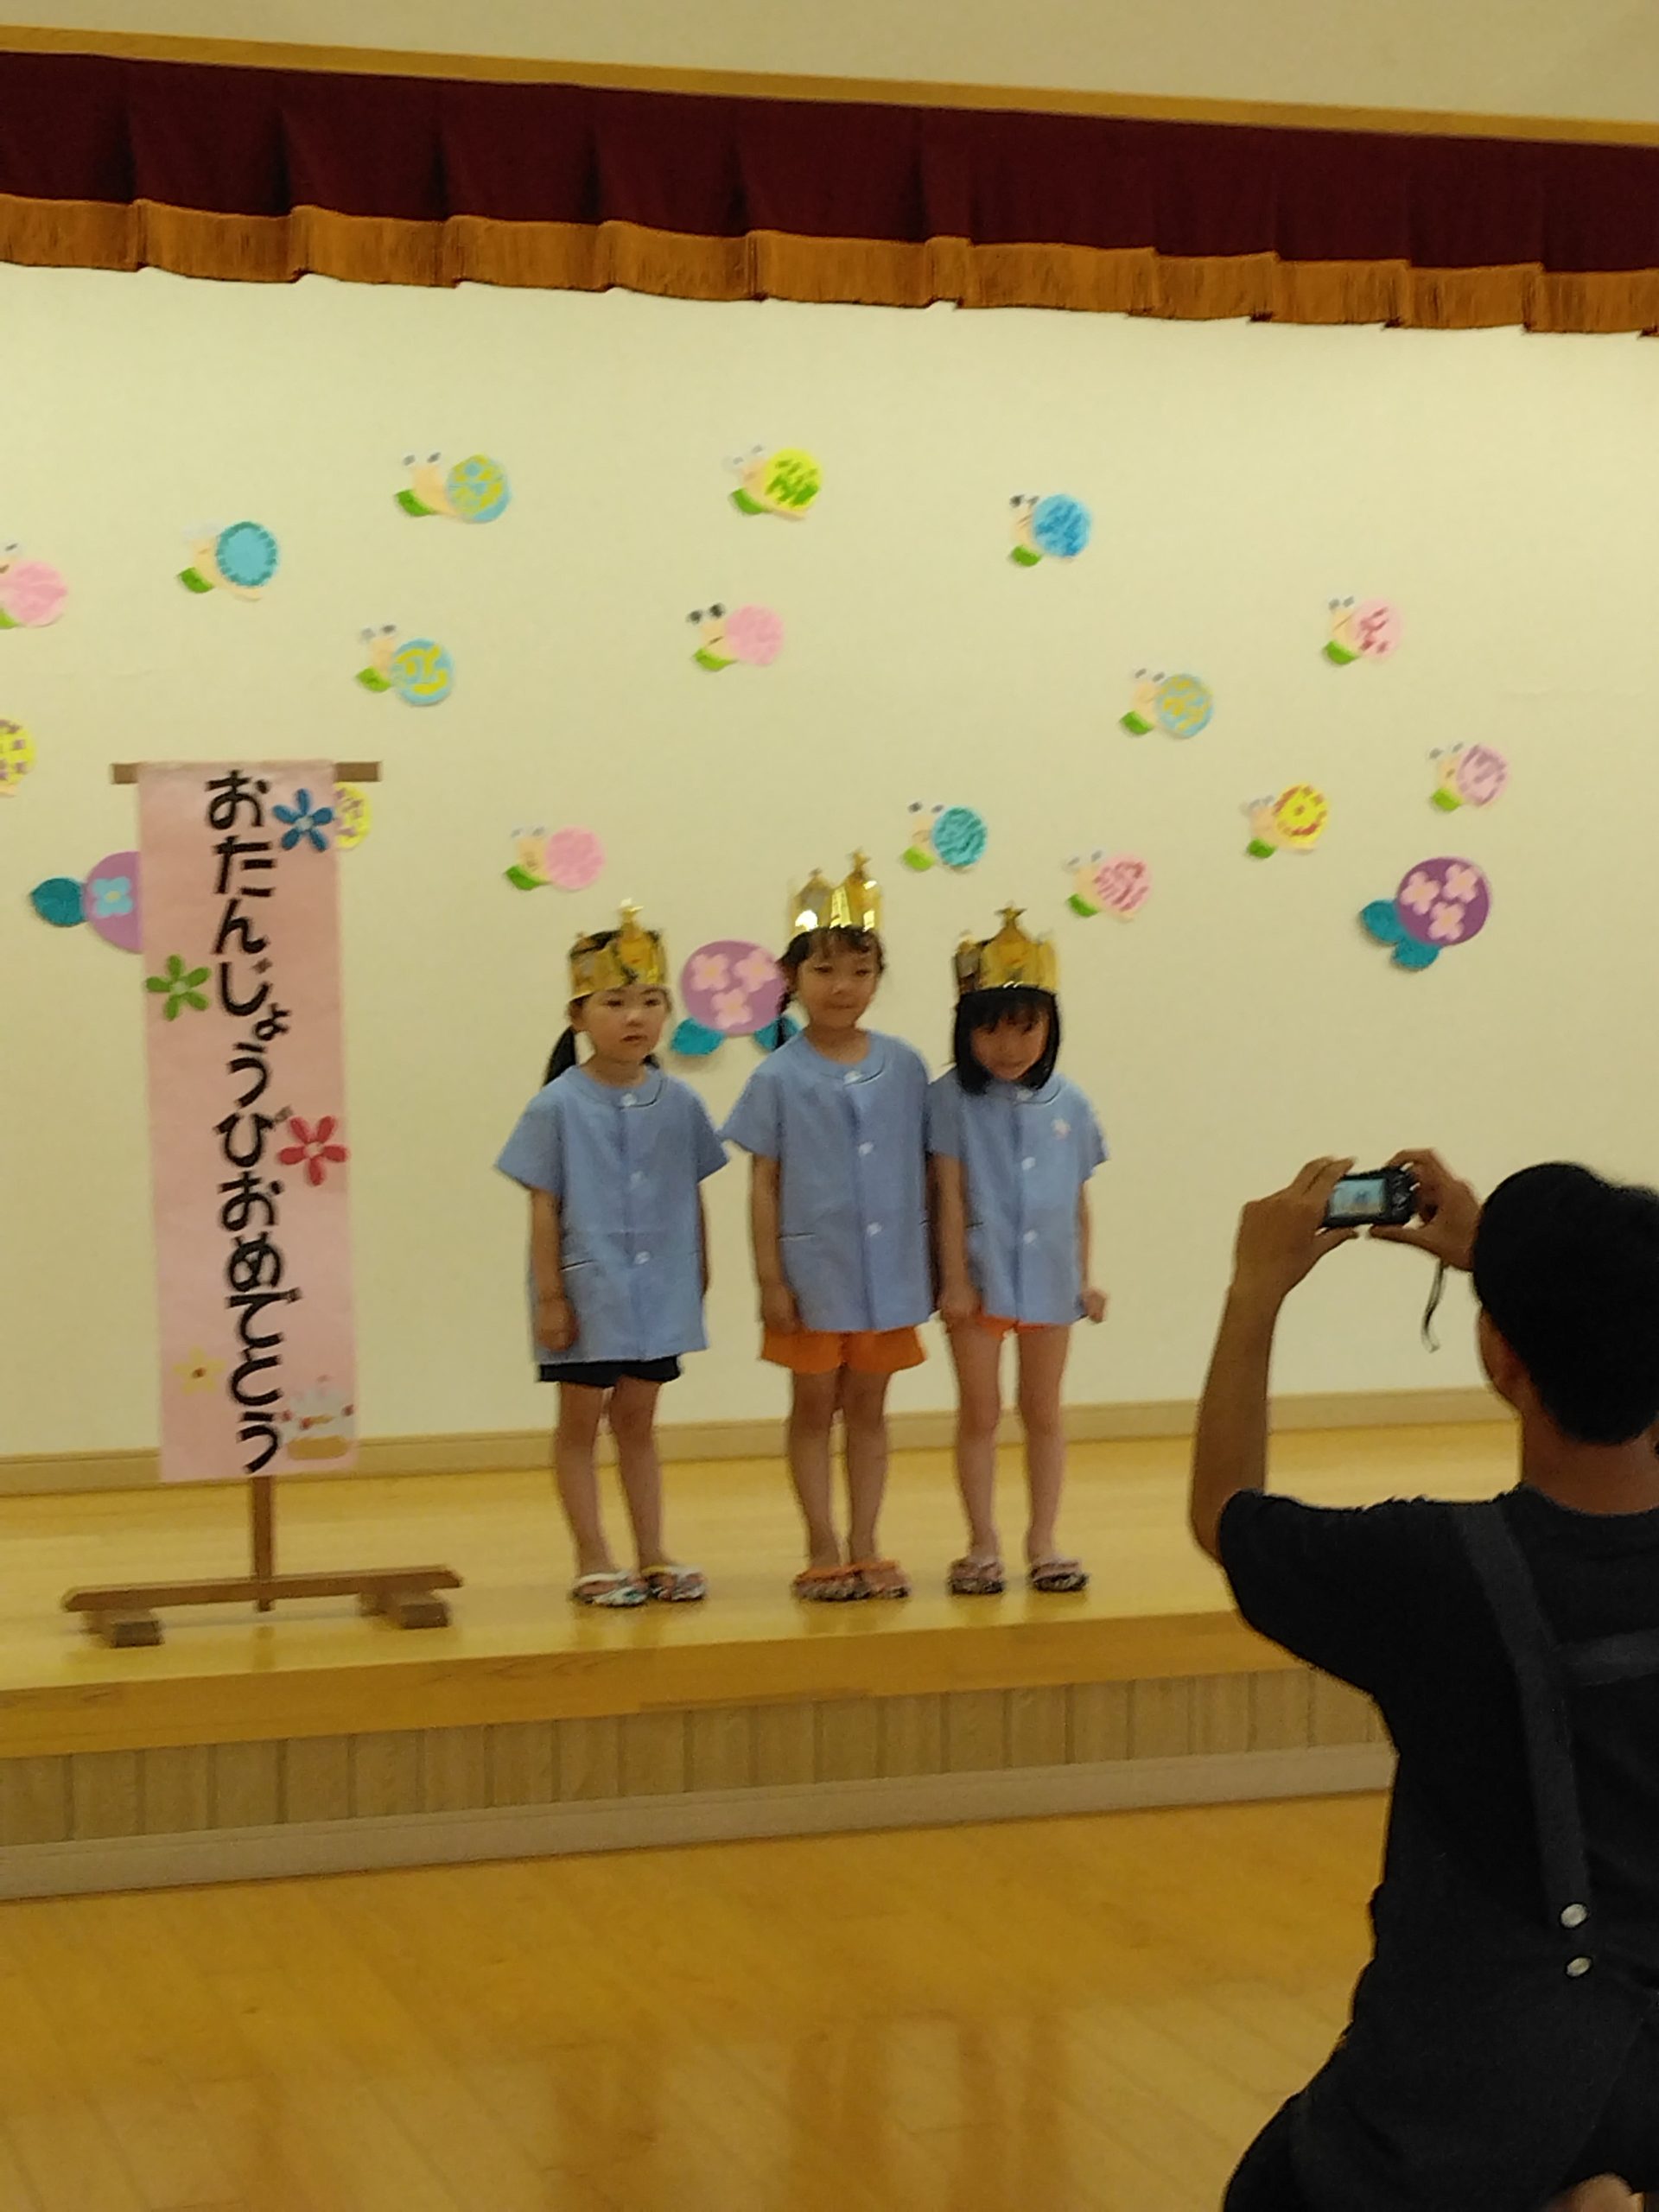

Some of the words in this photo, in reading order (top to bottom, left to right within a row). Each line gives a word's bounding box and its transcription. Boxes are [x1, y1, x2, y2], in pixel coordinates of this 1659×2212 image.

[205, 769, 302, 1474] おたんじょうびおめでとう
